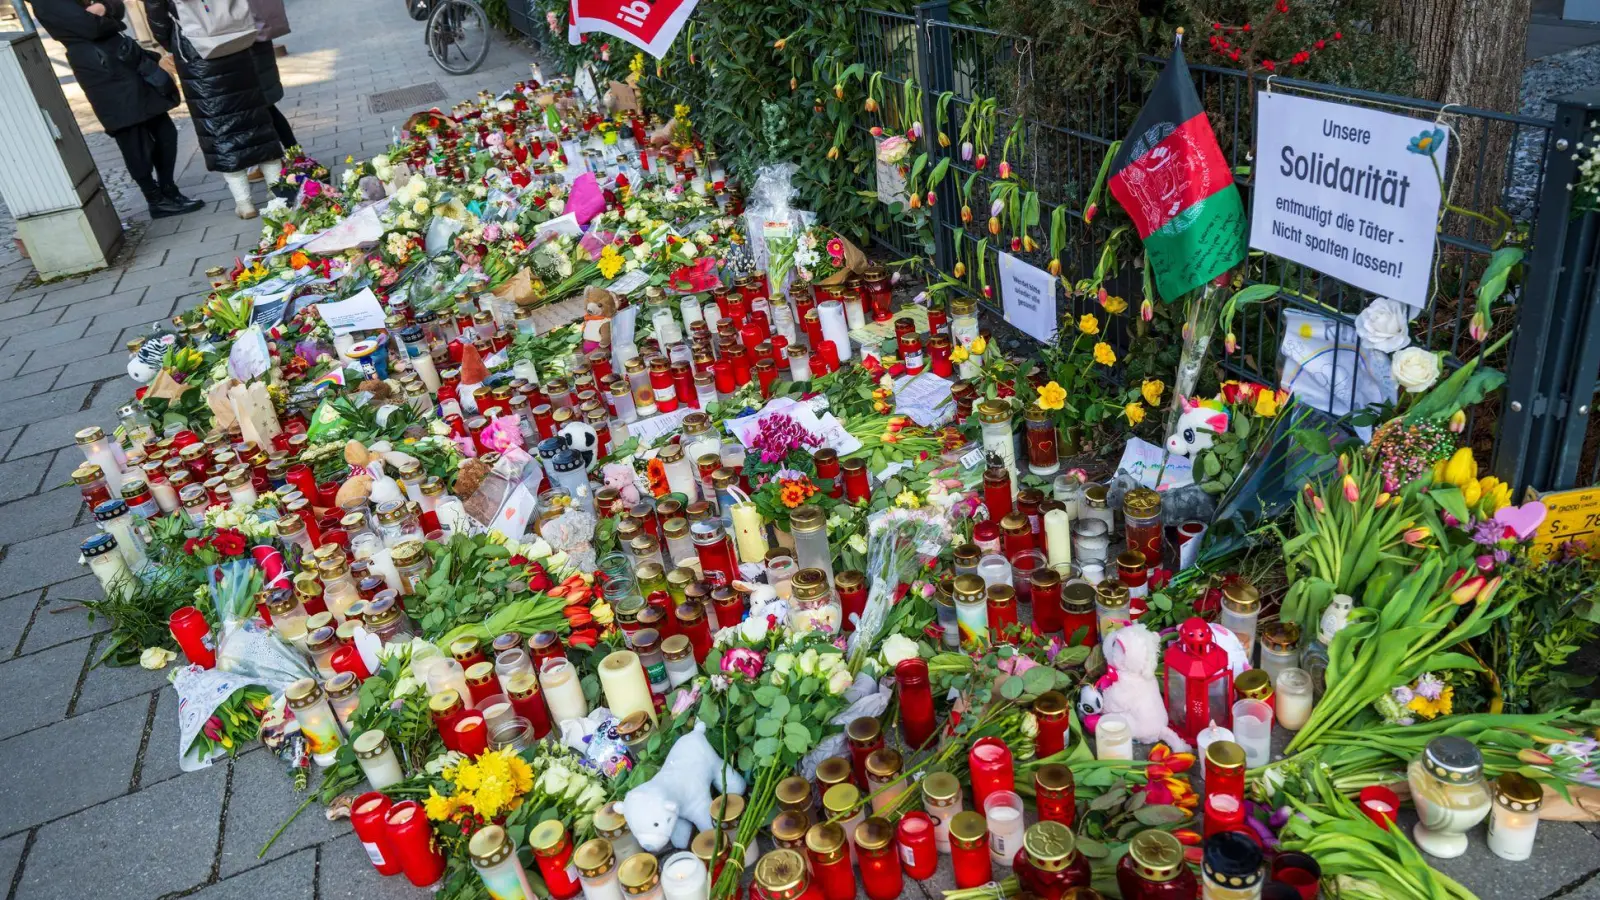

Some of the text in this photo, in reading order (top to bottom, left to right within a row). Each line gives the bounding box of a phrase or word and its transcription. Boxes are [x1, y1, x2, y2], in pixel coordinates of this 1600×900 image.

[1322, 118, 1371, 145] Unsere
[1280, 145, 1410, 208] Solidarität
[1276, 196, 1333, 228] entmutigt
[1335, 212, 1355, 233] die
[1358, 218, 1395, 245] Täter
[1272, 219, 1403, 279] Nicht spalten lassen!
[1550, 520, 1561, 533] S
